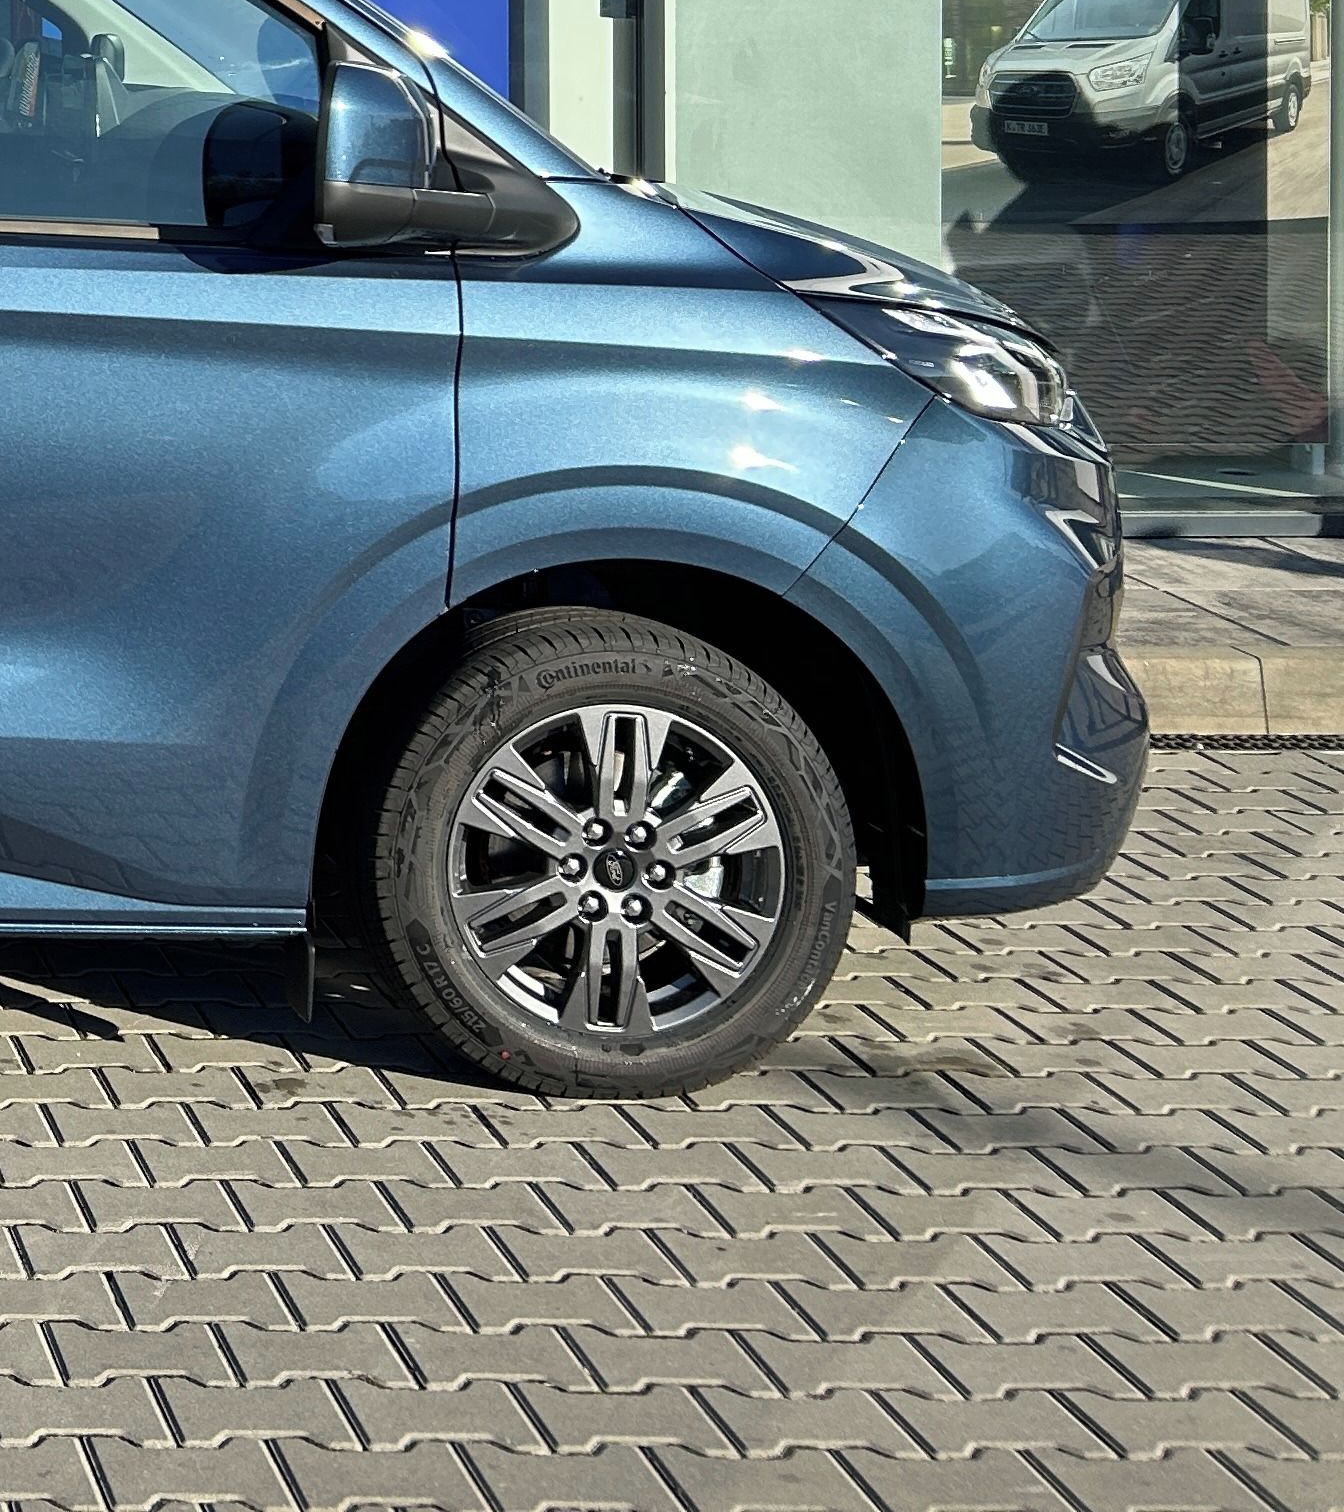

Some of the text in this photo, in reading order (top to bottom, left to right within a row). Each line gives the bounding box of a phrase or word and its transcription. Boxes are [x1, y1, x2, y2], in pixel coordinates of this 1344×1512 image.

[535, 657, 637, 691] Continental
[416, 943, 431, 956] C
[441, 988, 487, 1033] 215/60
